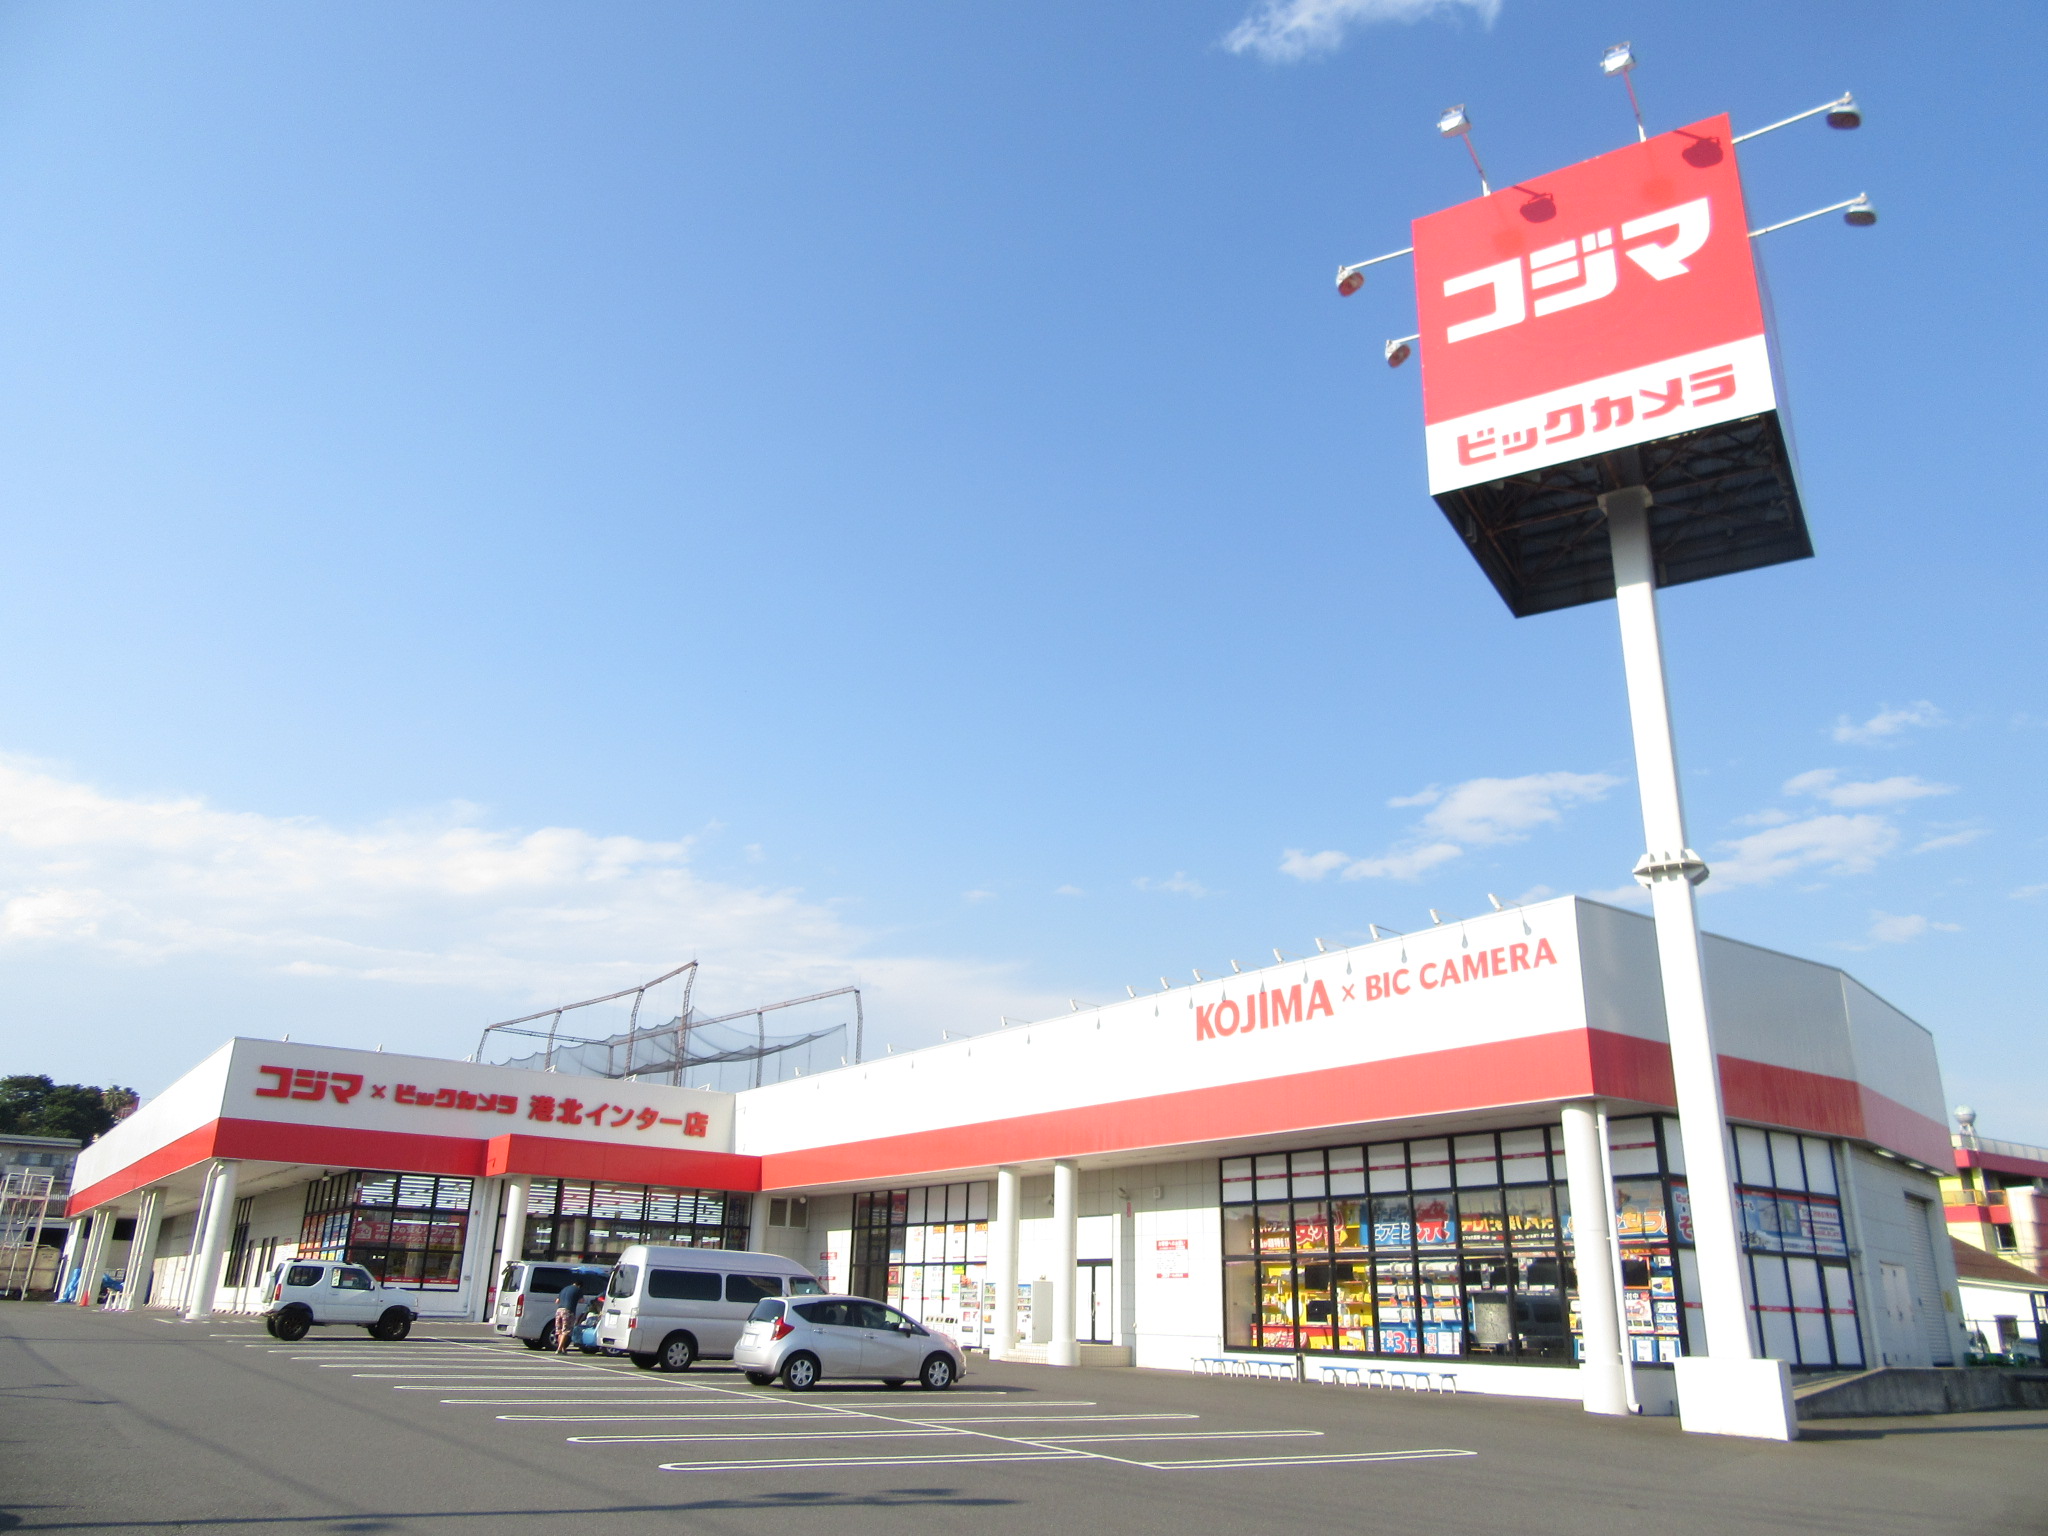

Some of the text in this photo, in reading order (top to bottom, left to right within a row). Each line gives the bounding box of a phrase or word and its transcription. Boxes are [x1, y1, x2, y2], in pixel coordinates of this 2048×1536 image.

[1443, 197, 1711, 344] コジマ
[1456, 363, 1737, 467] ビックカメラ
[1196, 979, 1334, 1041] KOJIMA
[1366, 968, 1411, 1001] BIC
[1419, 937, 1558, 990] CAMERA
[256, 1065, 363, 1104] コジマ
[394, 1083, 518, 1114] ビックカメラ
[528, 1095, 710, 1138] 港北インター店
